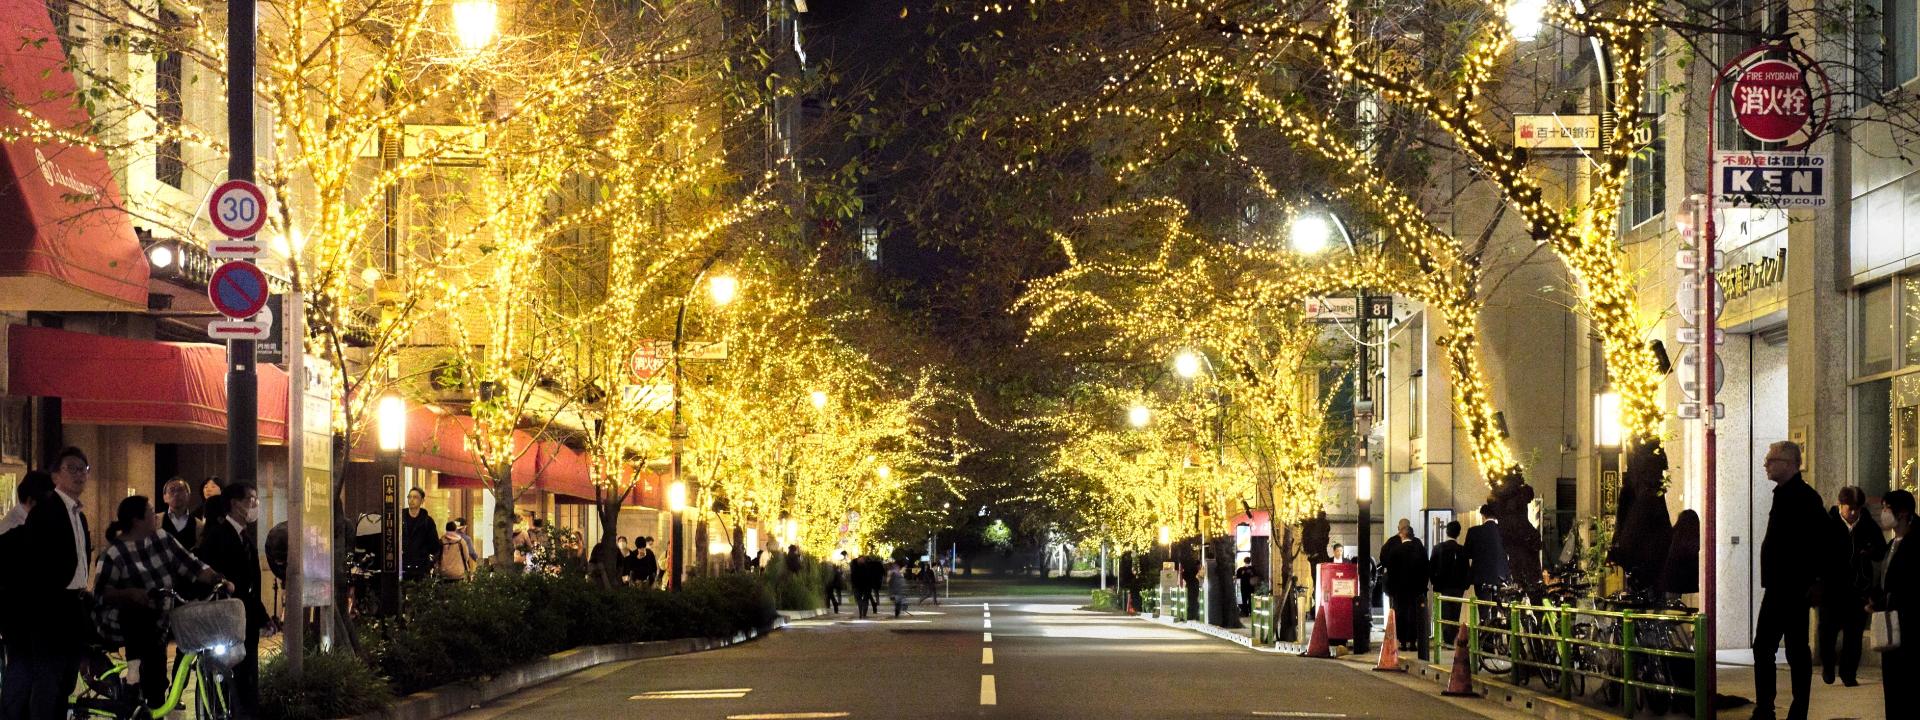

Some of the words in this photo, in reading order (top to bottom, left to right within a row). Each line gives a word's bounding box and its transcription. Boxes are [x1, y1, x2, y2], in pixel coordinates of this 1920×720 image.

[1746, 71, 1763, 81] FIRE
[1765, 71, 1799, 81] HYDRANT
[1740, 85, 1807, 116] 消火栓
[1537, 127, 1596, 139] 百十四銀行
[1723, 155, 1825, 167] 不動産は信頼の
[1732, 170, 1813, 193] KEN
[223, 197, 254, 222] 30
[1373, 303, 1389, 316] 81
